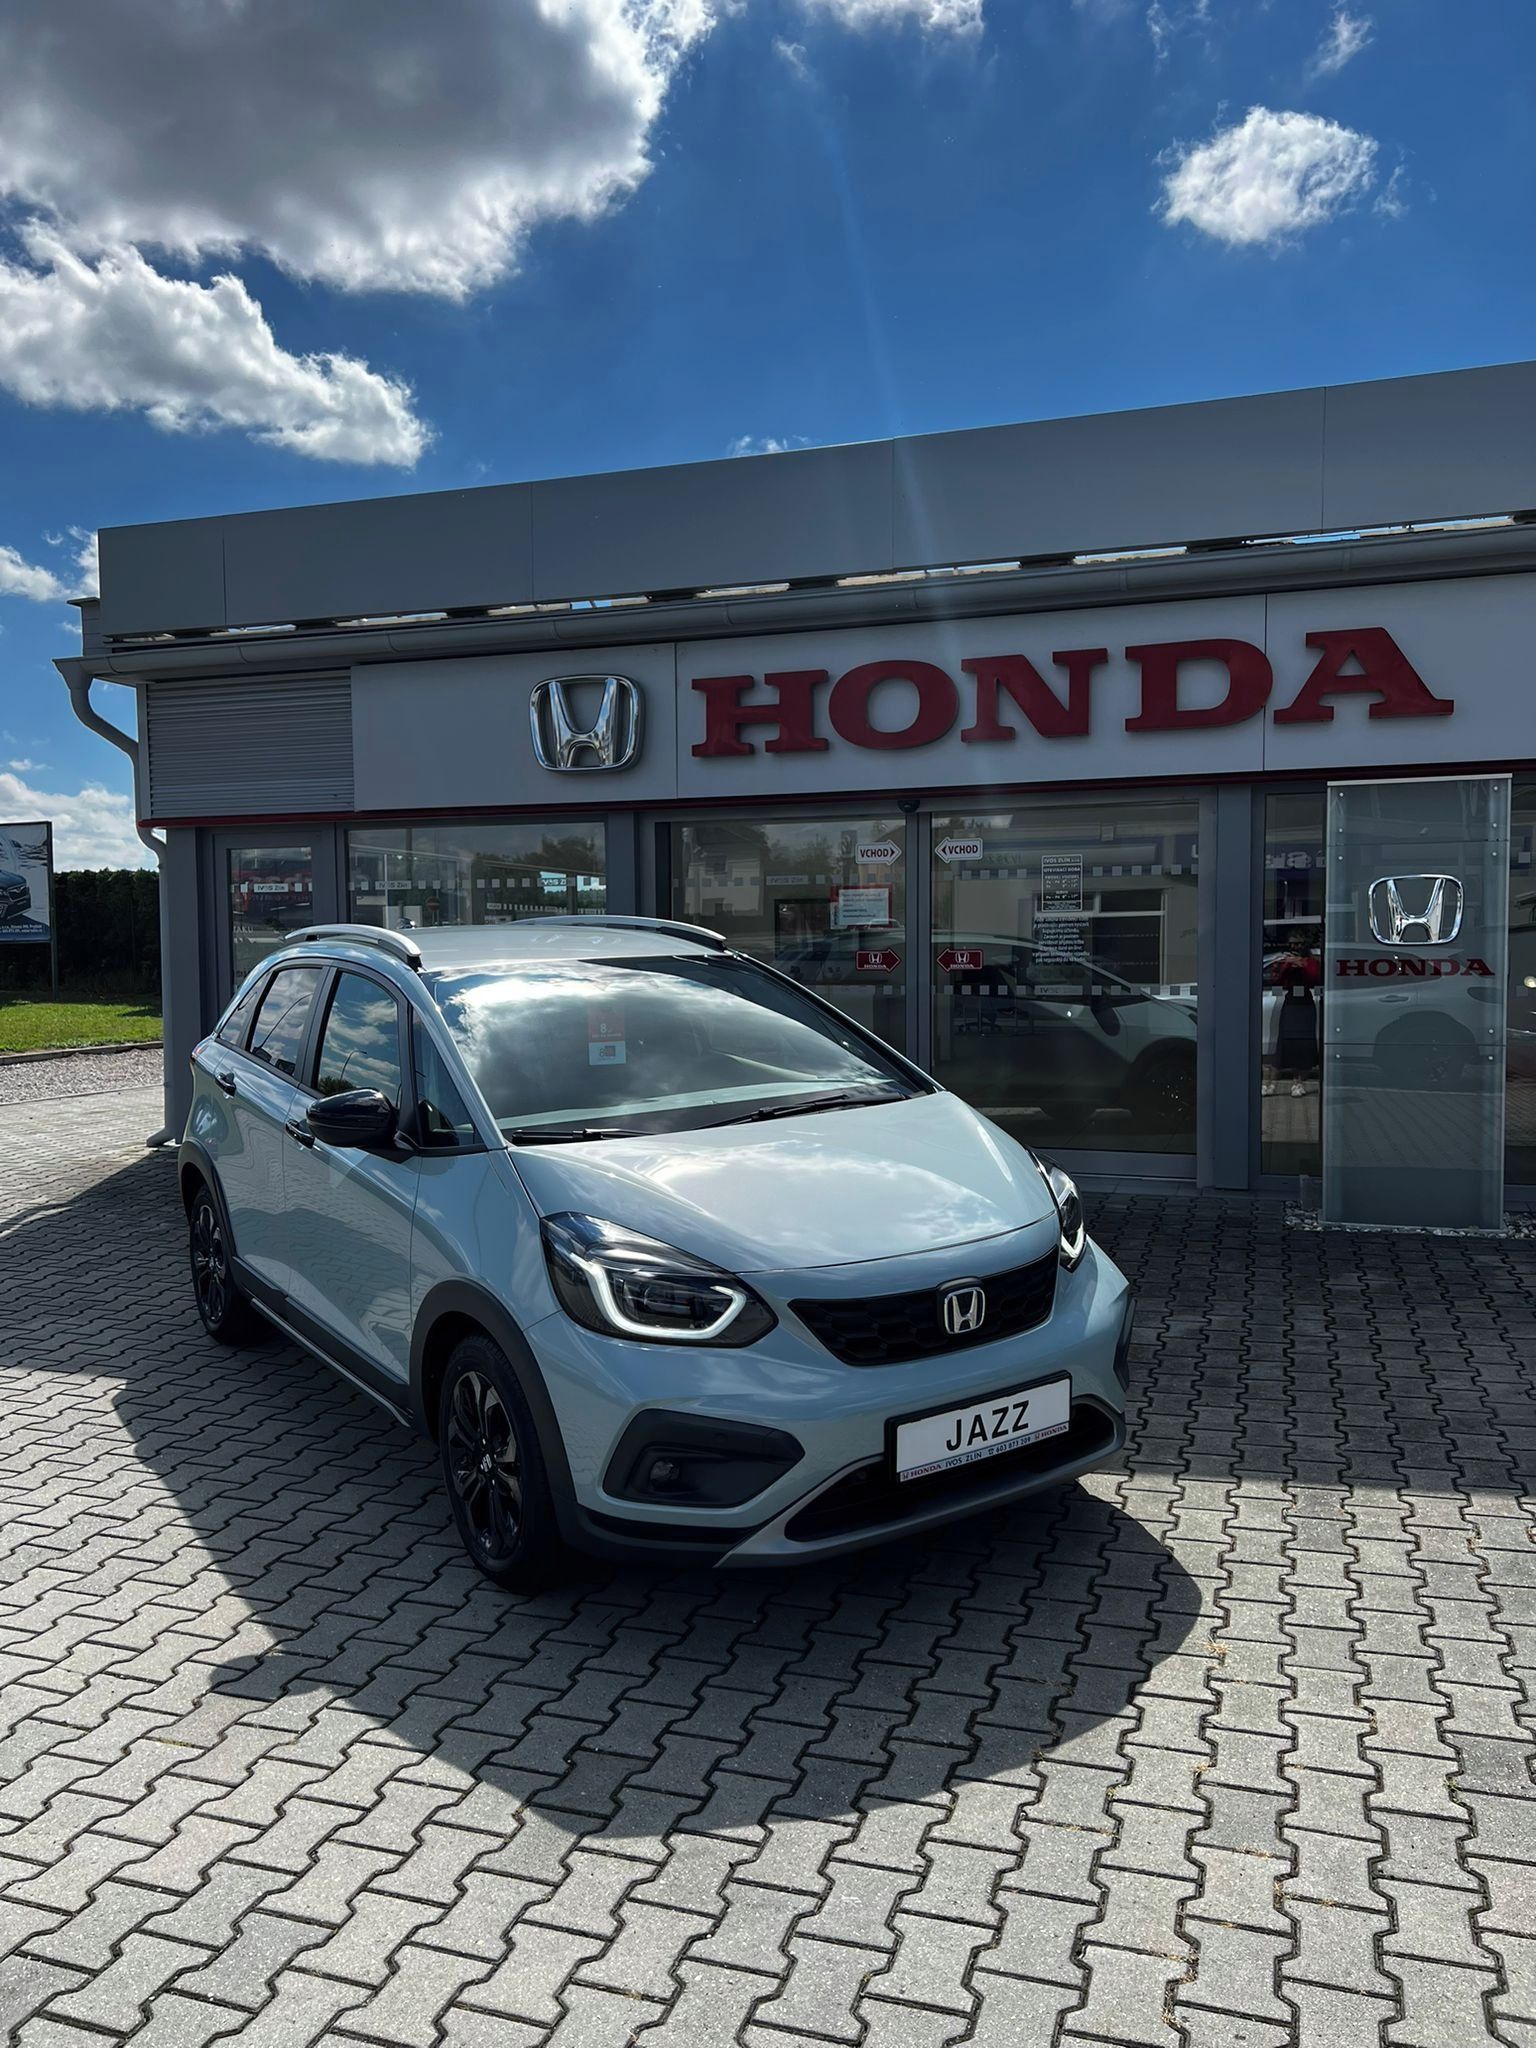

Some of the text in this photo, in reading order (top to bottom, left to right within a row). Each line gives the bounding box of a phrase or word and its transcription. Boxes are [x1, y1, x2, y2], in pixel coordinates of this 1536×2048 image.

[692, 627, 1453, 757] HONDA
[860, 848, 889, 858] VCHOD
[948, 845, 979, 855] VCHOD
[1336, 958, 1495, 977] HONDA
[946, 1400, 1030, 1452] JAZZ
[910, 1463, 942, 1477] HONDA
[1040, 1425, 1068, 1439] HONDA
